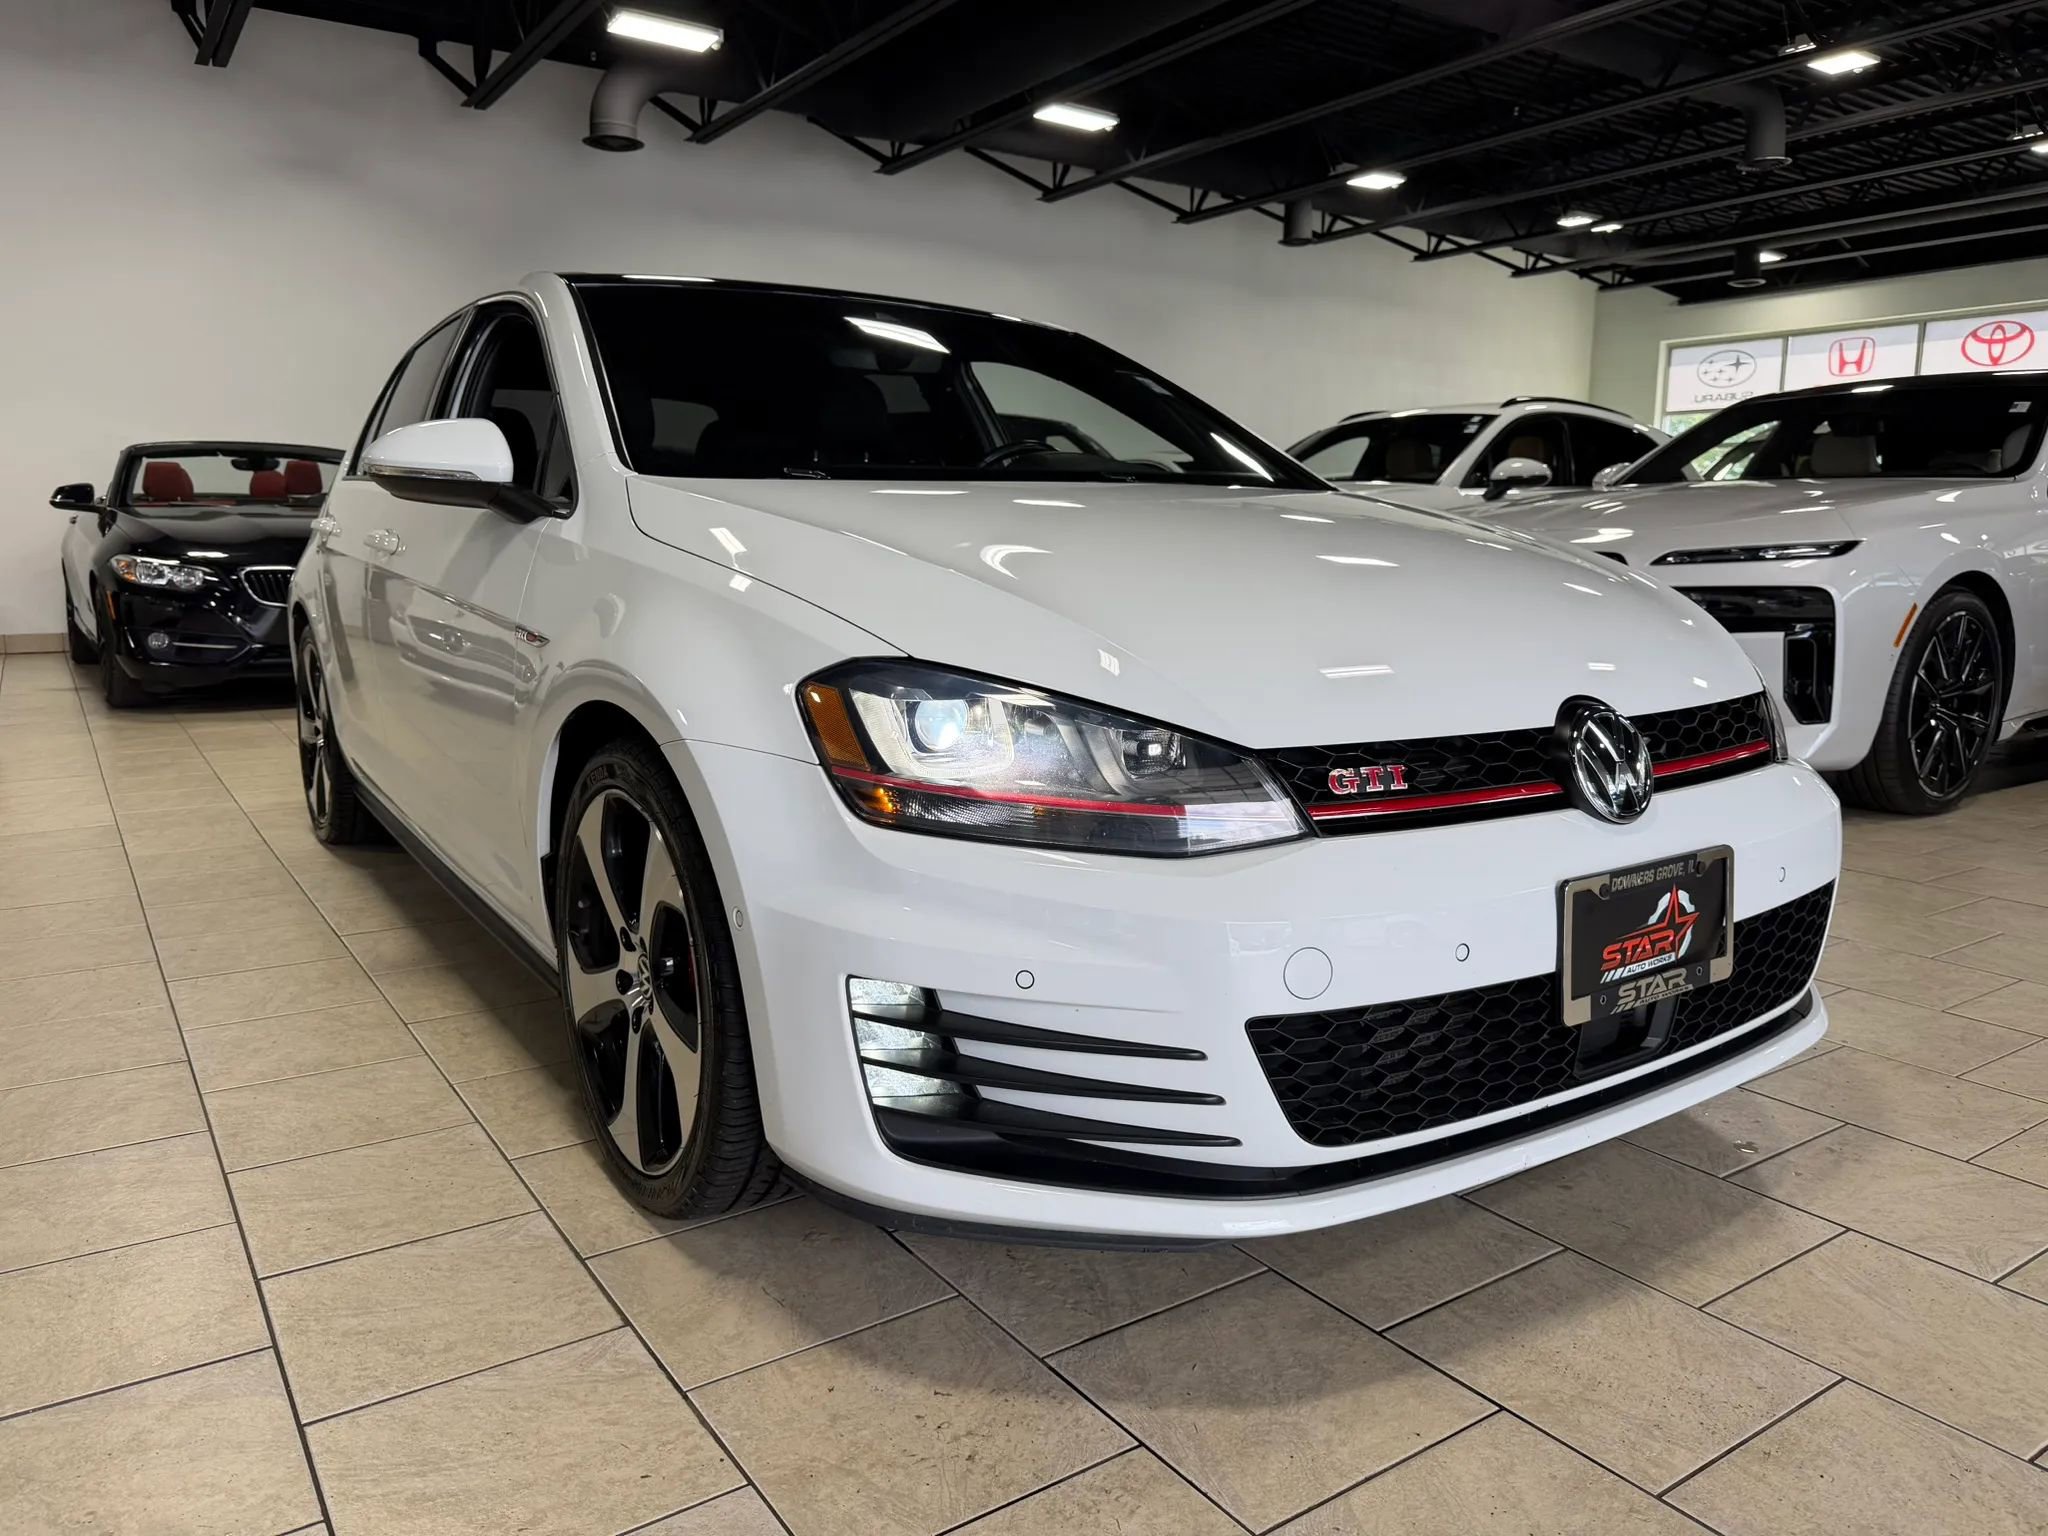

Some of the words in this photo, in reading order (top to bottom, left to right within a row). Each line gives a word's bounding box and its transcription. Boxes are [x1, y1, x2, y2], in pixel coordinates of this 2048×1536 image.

[1328, 765, 1408, 795] GTI
[1611, 869, 1655, 893] DOWNERS
[1600, 929, 1675, 971] STAR
[1626, 962, 1647, 974] AUTO
[1648, 954, 1673, 968] WORKS
[1617, 967, 1687, 1005] STAR
